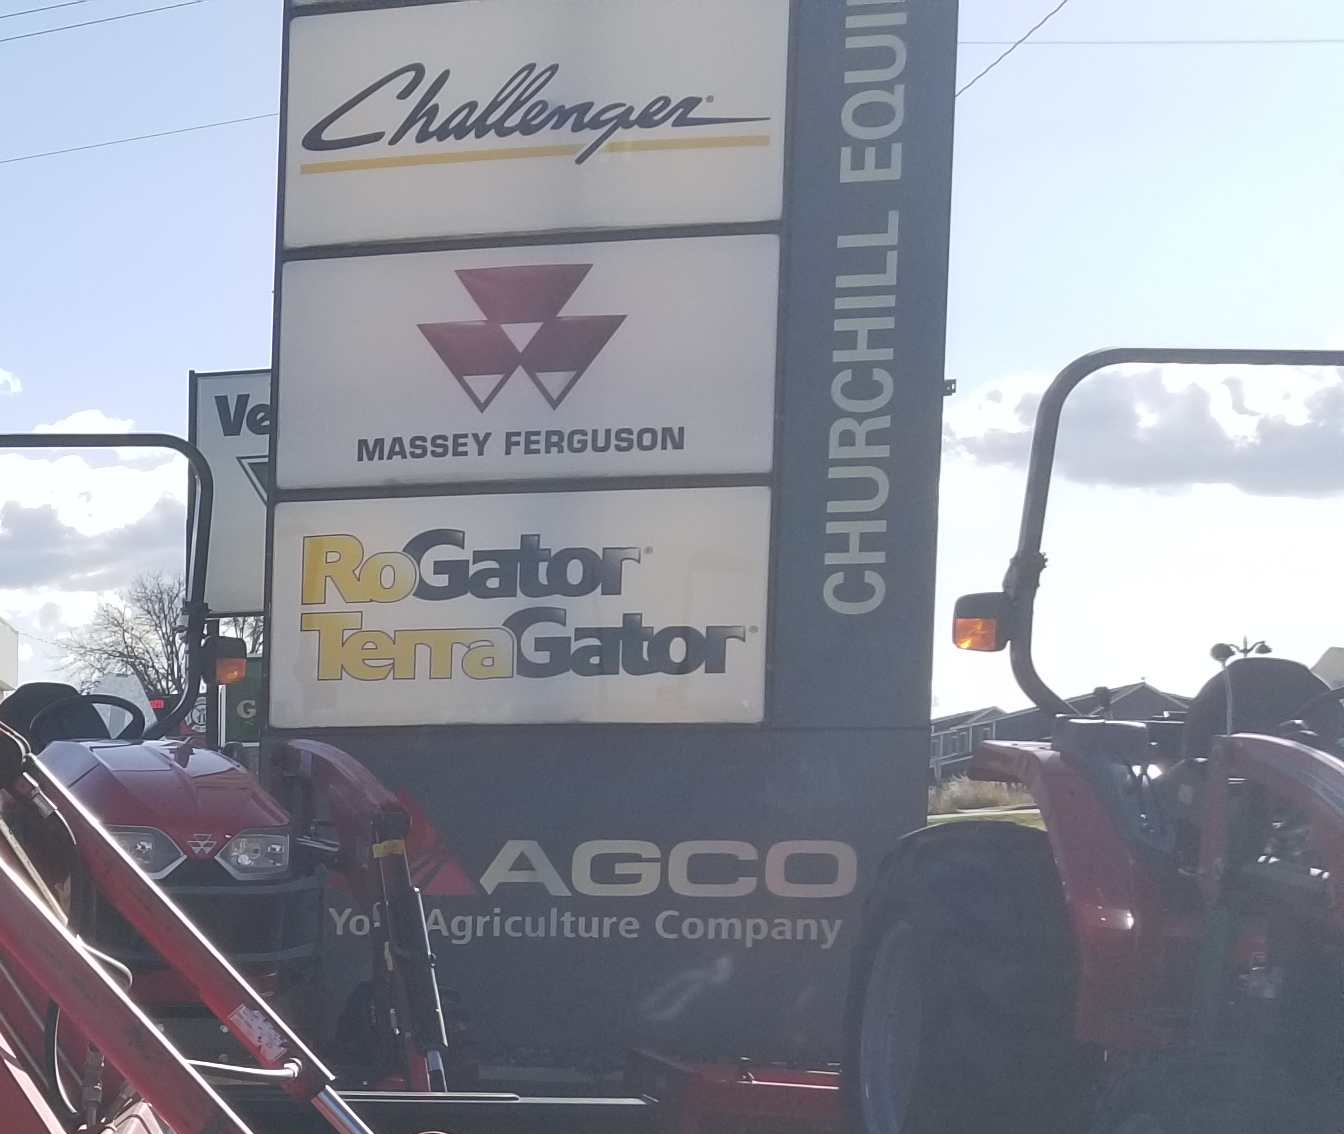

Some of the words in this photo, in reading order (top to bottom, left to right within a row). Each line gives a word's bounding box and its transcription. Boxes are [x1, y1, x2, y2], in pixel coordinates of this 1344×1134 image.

[301, 62, 771, 165] Challenger
[840, 0, 908, 183] EQUI
[214, 393, 271, 437] Ve
[356, 432, 492, 462] MASSEY
[504, 426, 685, 456] FERGUSON
[823, 210, 900, 615] CHURCHILL
[301, 528, 641, 605] RoGator
[300, 606, 746, 681] TerraGator
[479, 839, 858, 898] AGCO
[425, 908, 641, 945] Agriculture
[655, 909, 843, 949] Company
